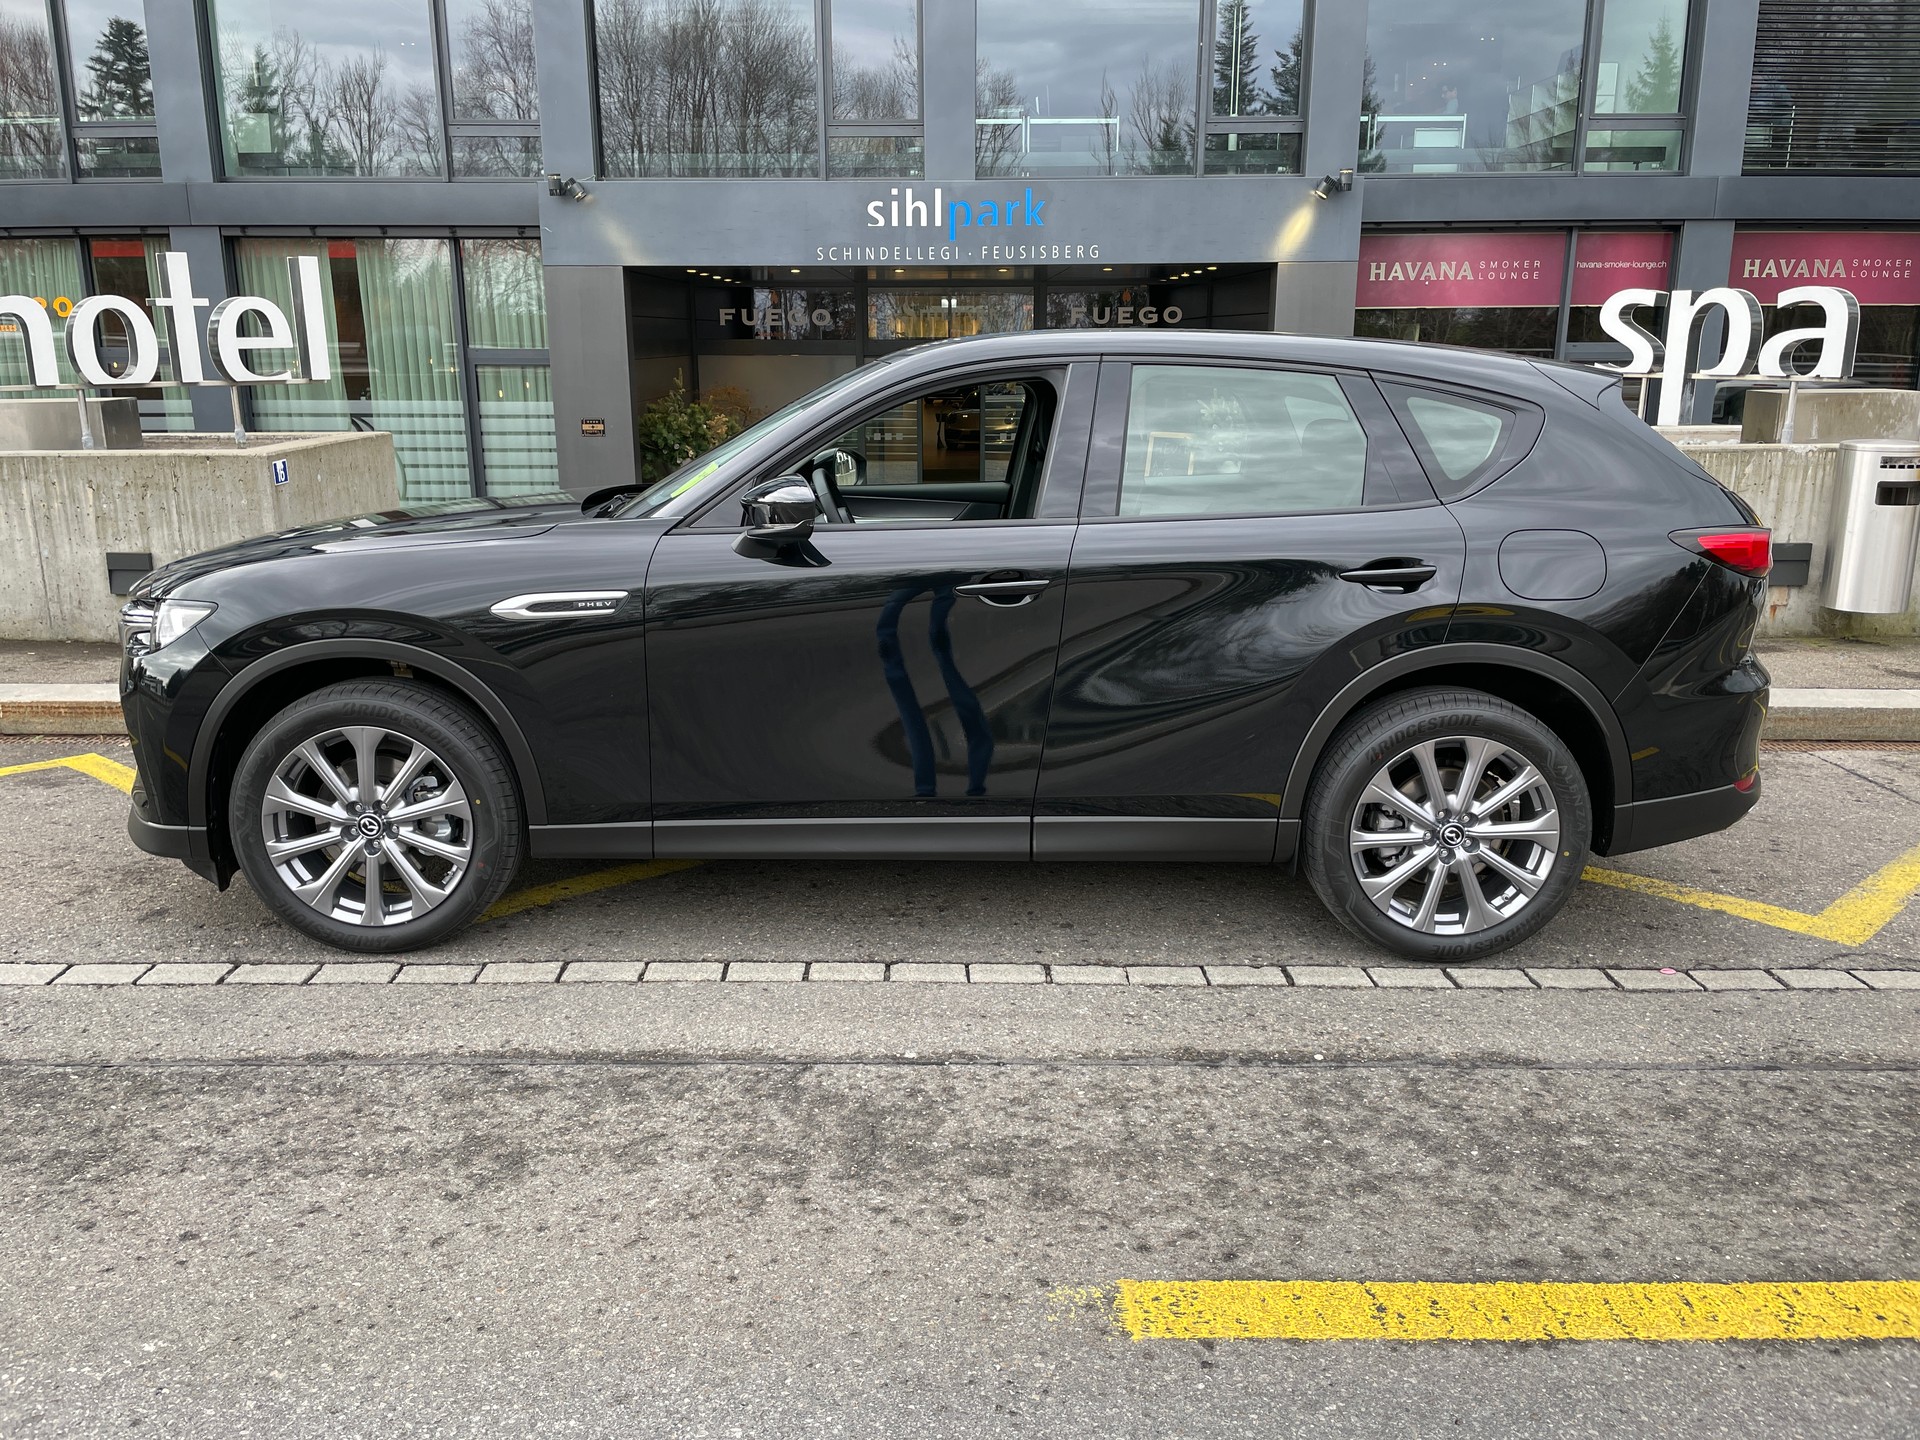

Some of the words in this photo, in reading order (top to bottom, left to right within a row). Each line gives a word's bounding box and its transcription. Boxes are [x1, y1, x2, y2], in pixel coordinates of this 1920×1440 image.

[867, 188, 1045, 242] sihlpark
[817, 246, 959, 261] SCHINDELLEGI
[982, 244, 1099, 259] FEUSISBERG
[1369, 261, 1474, 281] HAVANA
[1479, 260, 1541, 269] SMOKER
[1576, 260, 1667, 270] havana-smoker-lounge.ch
[1743, 258, 1846, 278] HAVANA
[1852, 259, 1912, 267] SMOKER
[1478, 271, 1540, 280] LOUNGE
[1851, 270, 1911, 279] LOUNGE
[719, 308, 831, 326] FUEGO
[1070, 306, 1183, 324] FUEGO
[1594, 286, 1860, 426] spa
